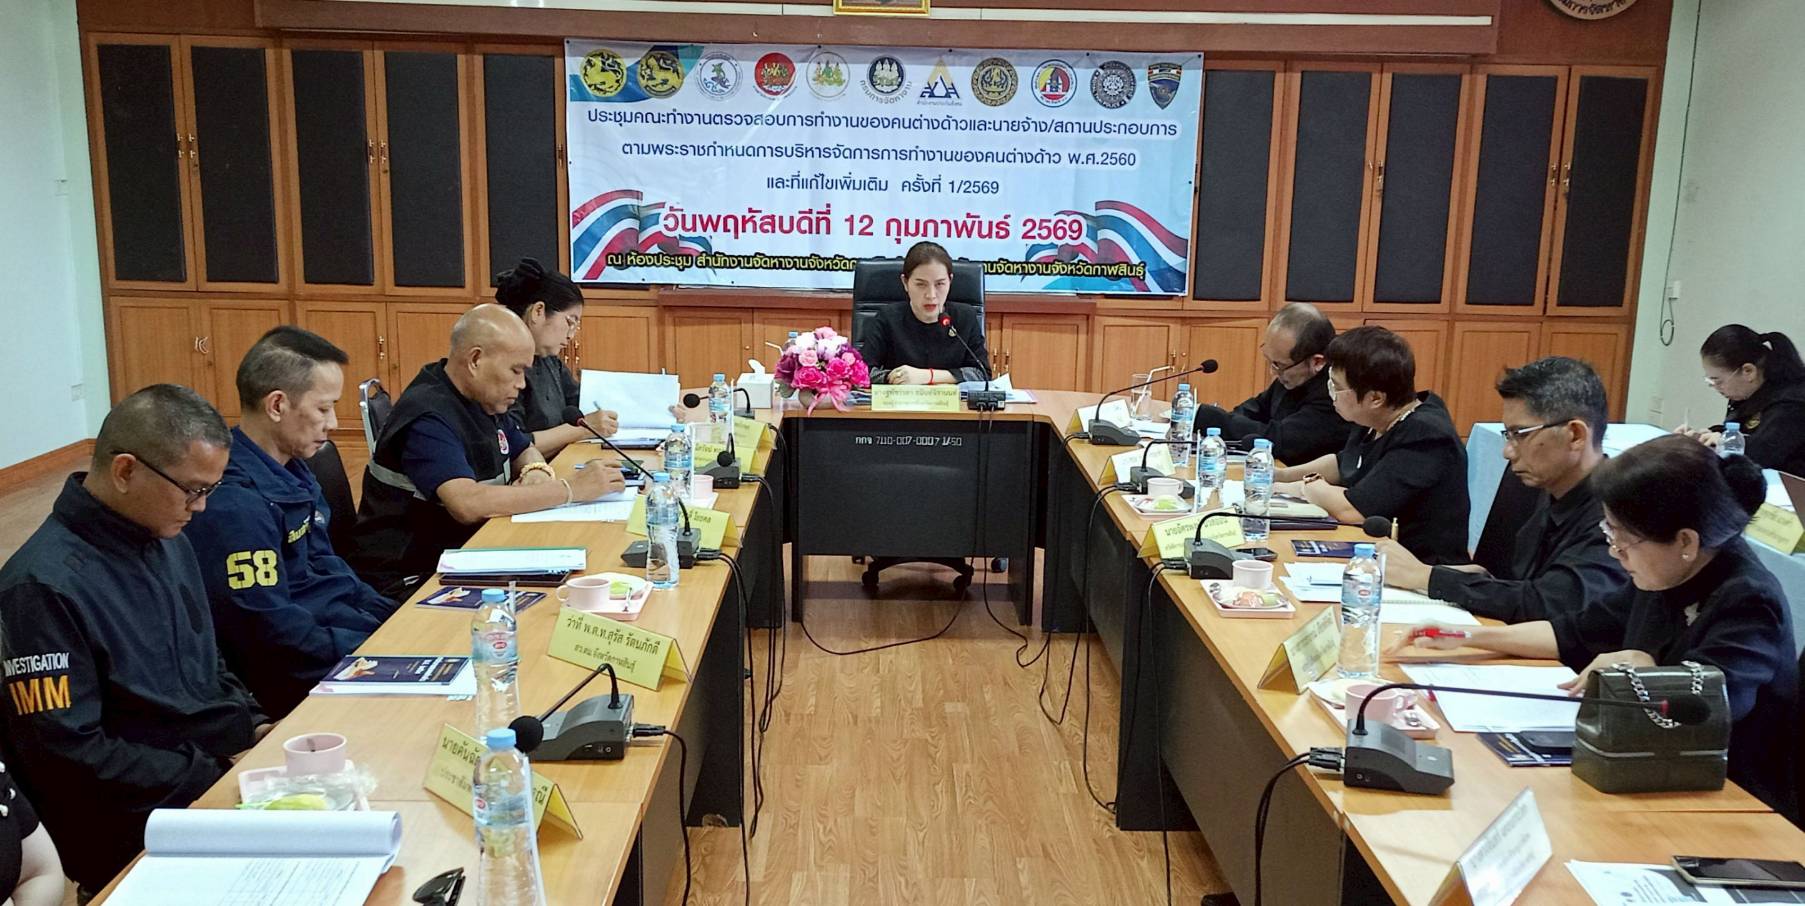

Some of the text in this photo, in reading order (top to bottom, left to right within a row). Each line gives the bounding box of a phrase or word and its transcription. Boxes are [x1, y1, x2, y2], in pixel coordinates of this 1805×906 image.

[588, 108, 1177, 136] ประชุมคณะทำงานตรวจสอบการทำงานของคนต่างด้าวและนายจ้าง/สถานประกอบการ
[622, 141, 1136, 166] ตามพระราชกำหนดการบริหารจัดการการทำงานของคนต่างด้าว พ.ศ.2560
[767, 171, 999, 194] และที่แก้ไขเพิ่มเติม ครั้งที่ 1/2569
[663, 203, 1083, 244] วันพฤหัสบดีที่ 12 กุมภาพันธ์ 2569
[607, 252, 1145, 278] ณ ห้องประชุม สำนักงานจัดหางานจังหวัดก านจัดหางานจังหวัดกาฬสินธุ์
[226, 549, 278, 590] 58
[3, 652, 70, 677] INVESTIGATION
[9, 675, 71, 716] IMM
